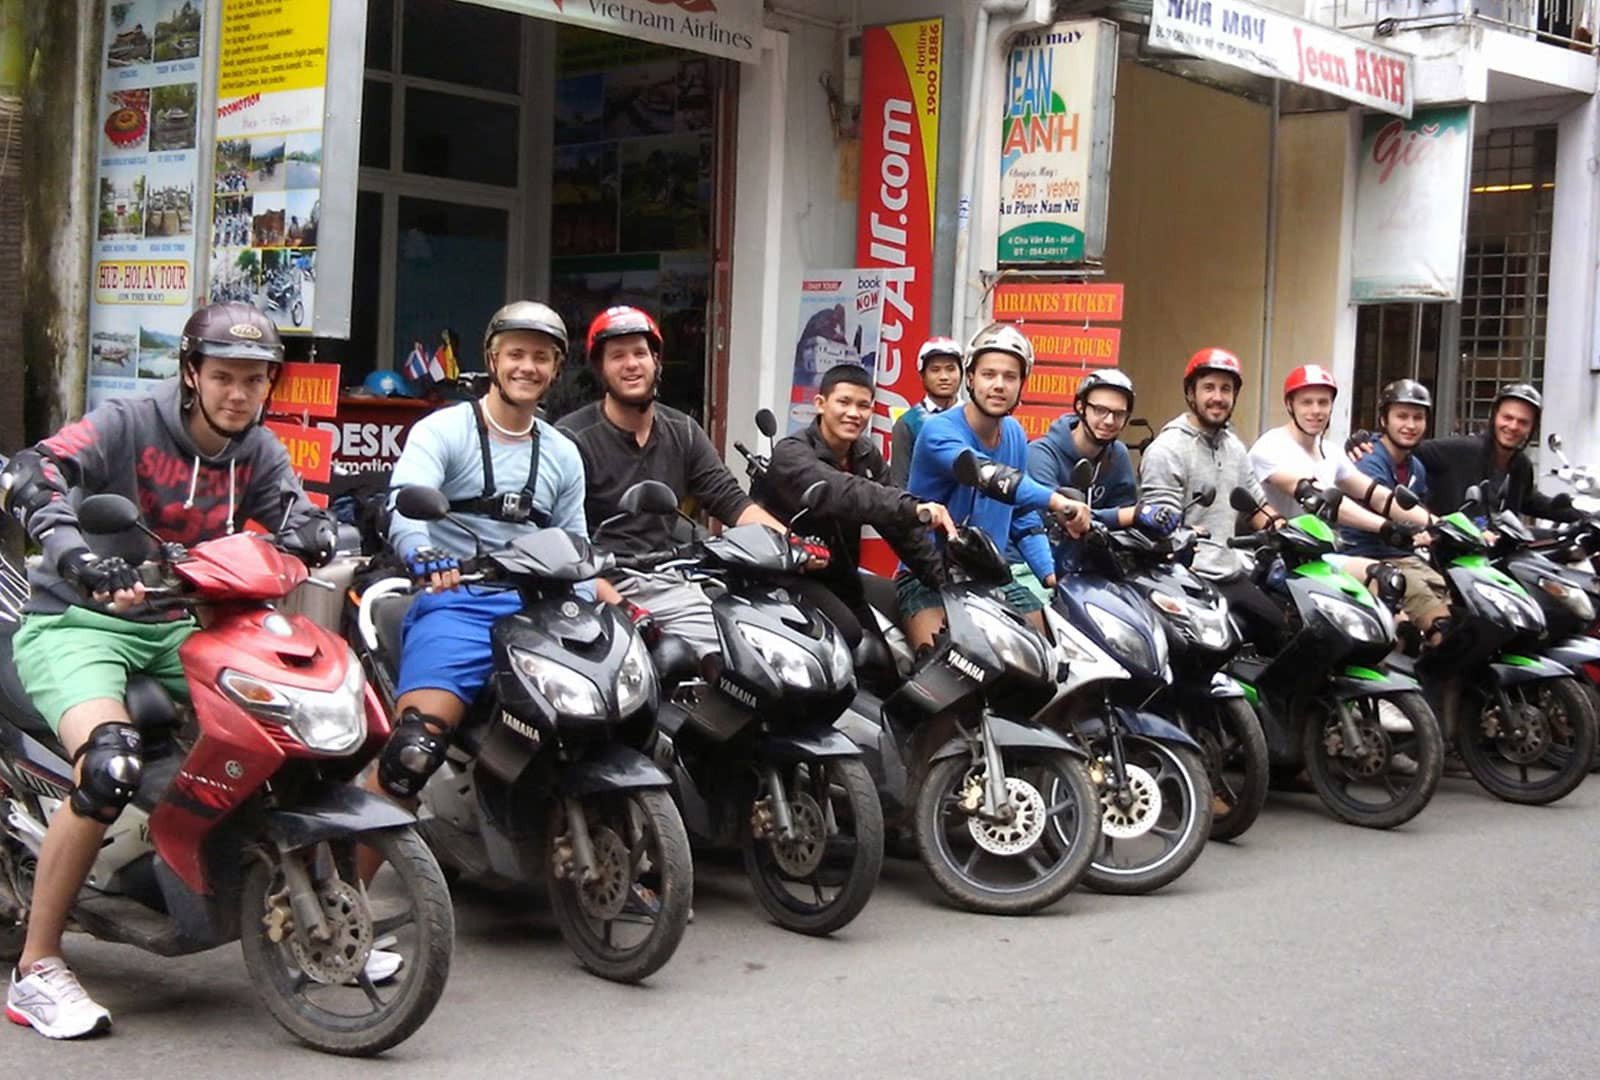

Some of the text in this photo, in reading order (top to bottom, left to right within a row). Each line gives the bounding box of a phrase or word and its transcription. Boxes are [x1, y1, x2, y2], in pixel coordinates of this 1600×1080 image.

[588, 0, 753, 50] Vietnam Airlines
[1222, 9, 1266, 44] MAY
[916, 25, 928, 75] Hotline
[927, 24, 940, 116] 1900 1886
[1293, 26, 1350, 85] Jean
[1355, 47, 1406, 106] ANH
[217, 92, 261, 118] PROMOTION
[1003, 112, 1080, 156] ANH
[1039, 199, 1062, 214] Nam
[98, 265, 119, 289] HUE
[124, 265, 141, 289] HOI
[143, 265, 158, 289] AN
[160, 265, 186, 290] TOUR
[858, 276, 881, 289] book
[857, 291, 880, 311] NOW
[995, 292, 1116, 313] AIRLINES TICKET
[1031, 335, 1112, 358] GROUP TOURS
[291, 376, 333, 405] RENTAL
[1027, 374, 1067, 394] RIDER
[279, 436, 321, 470] APS
[948, 649, 985, 682] YAMAHA
[719, 678, 757, 709] YAMAHA
[501, 710, 540, 743] YAMAHA
